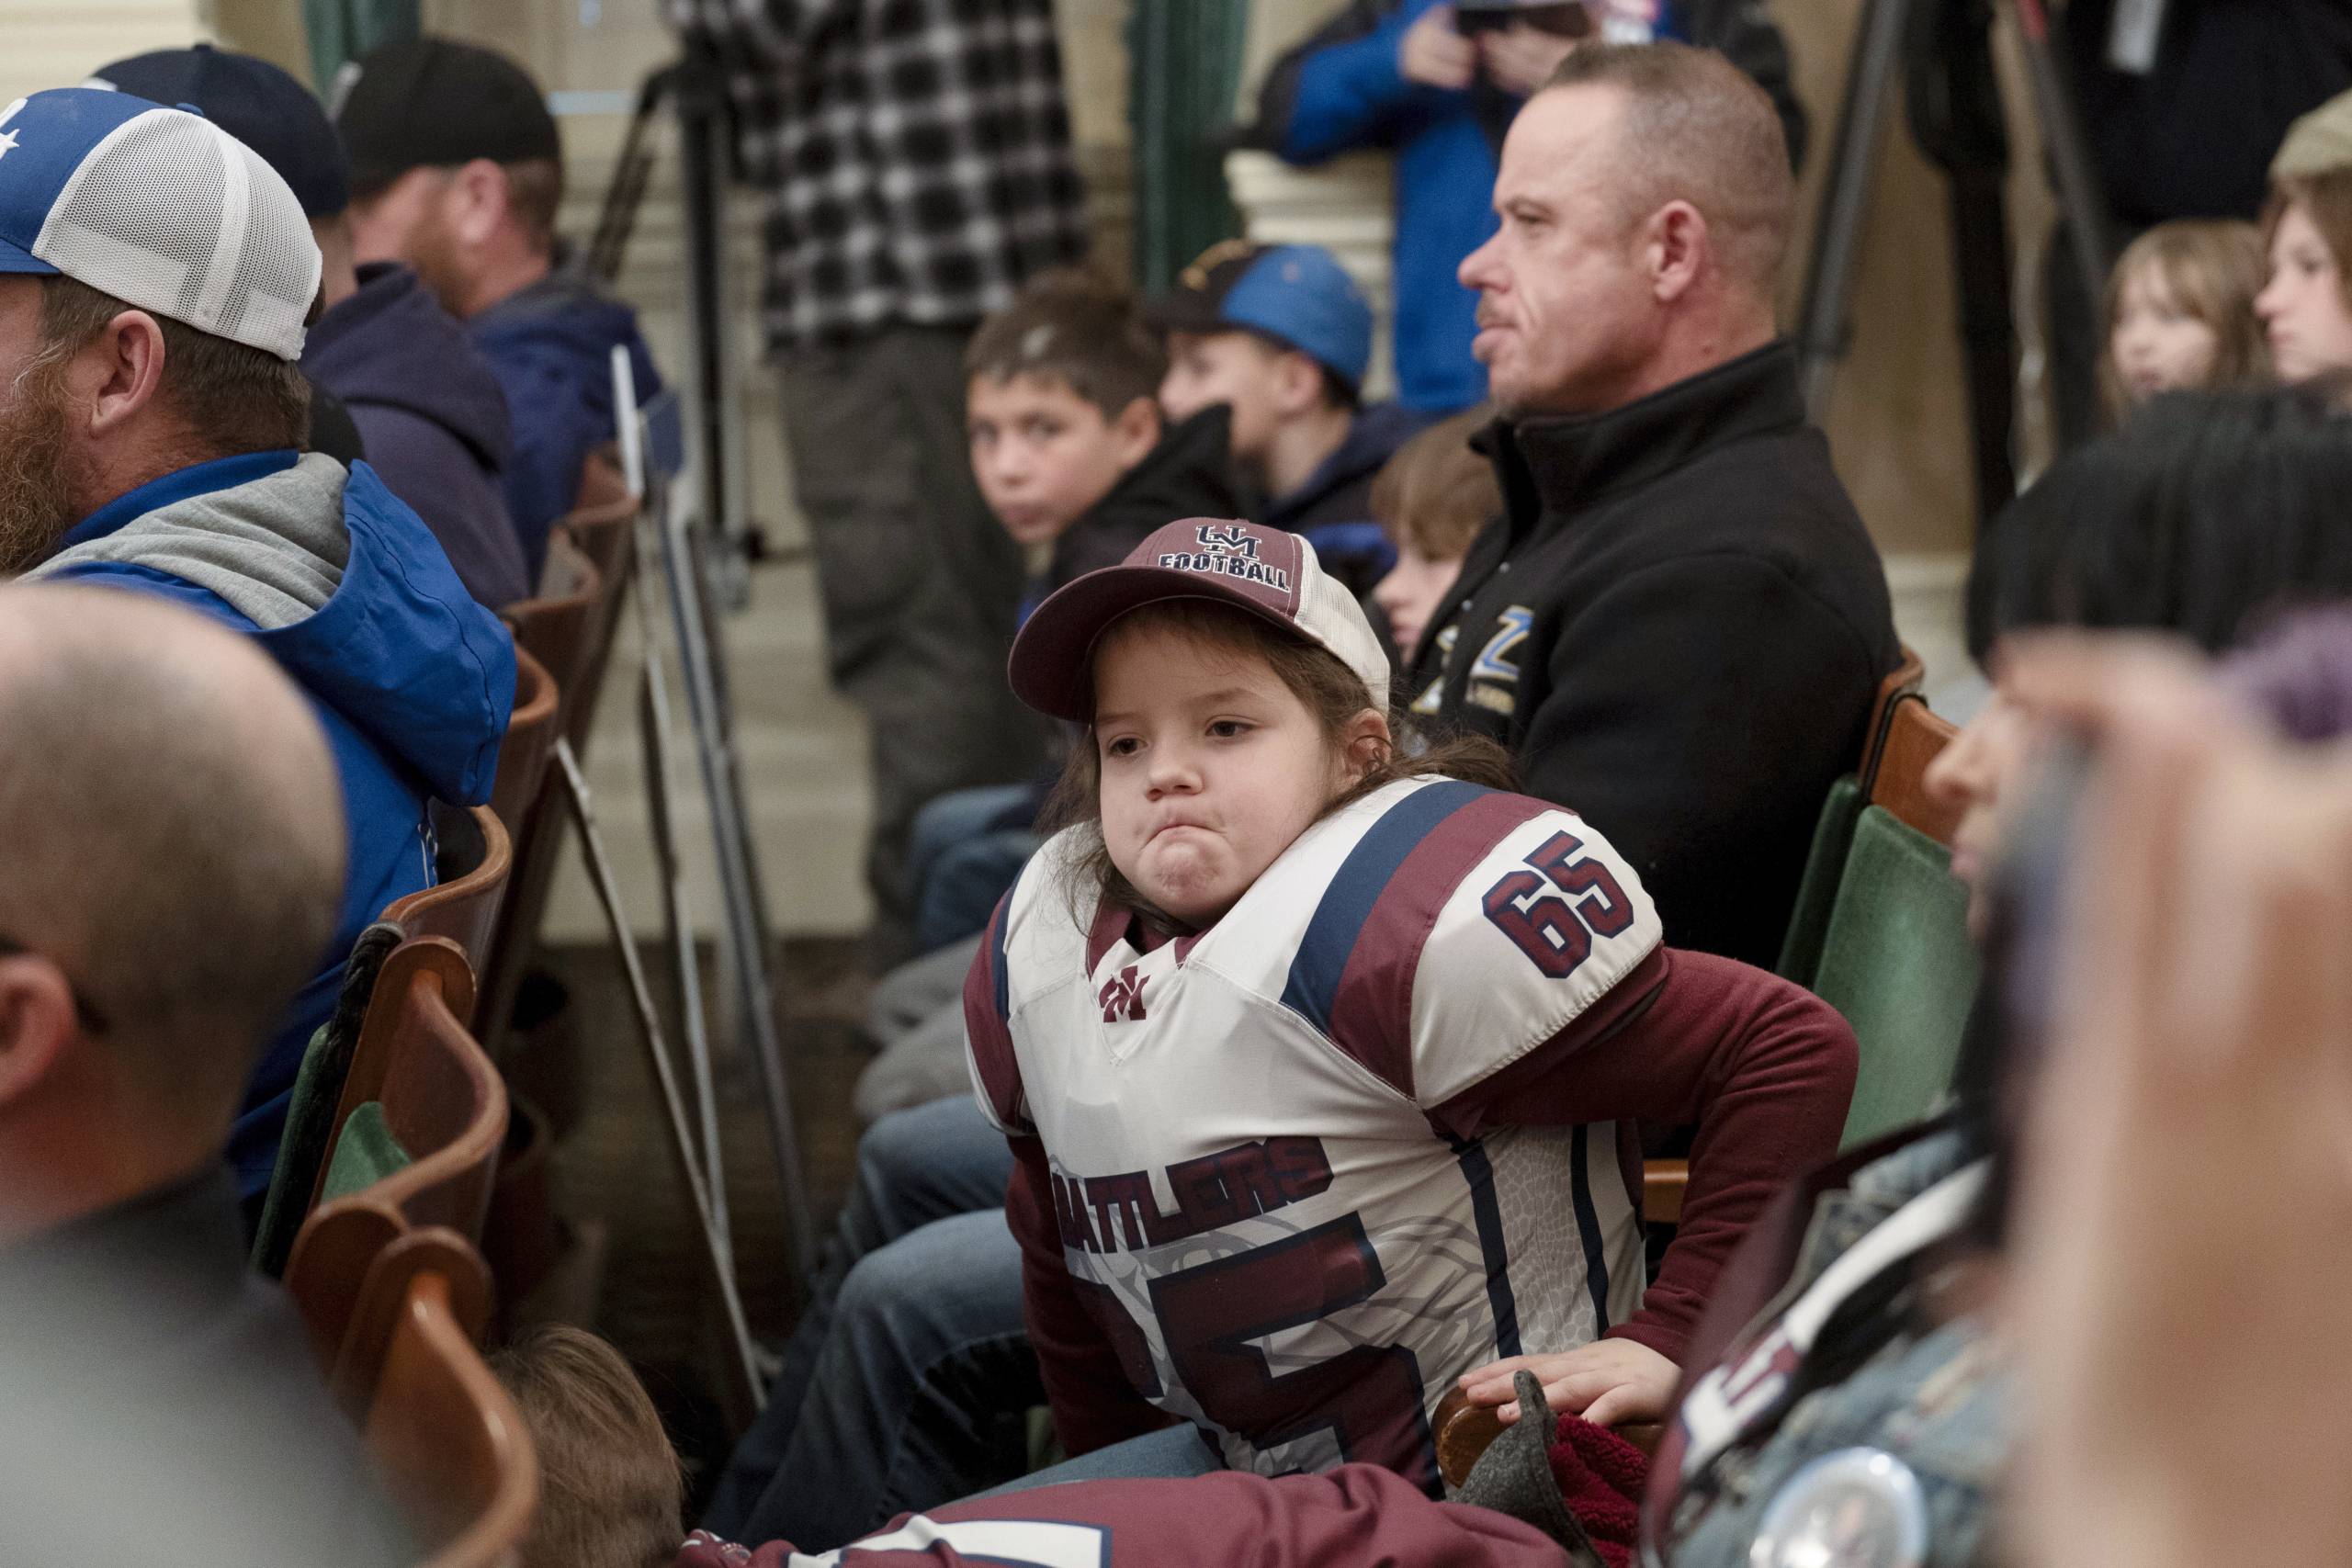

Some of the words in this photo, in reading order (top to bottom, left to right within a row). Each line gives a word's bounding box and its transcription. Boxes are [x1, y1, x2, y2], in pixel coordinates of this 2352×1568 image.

[1159, 552, 1290, 592] FOOTBALL
[1482, 829, 1634, 979] 65
[1070, 1211, 1449, 1501] 5
